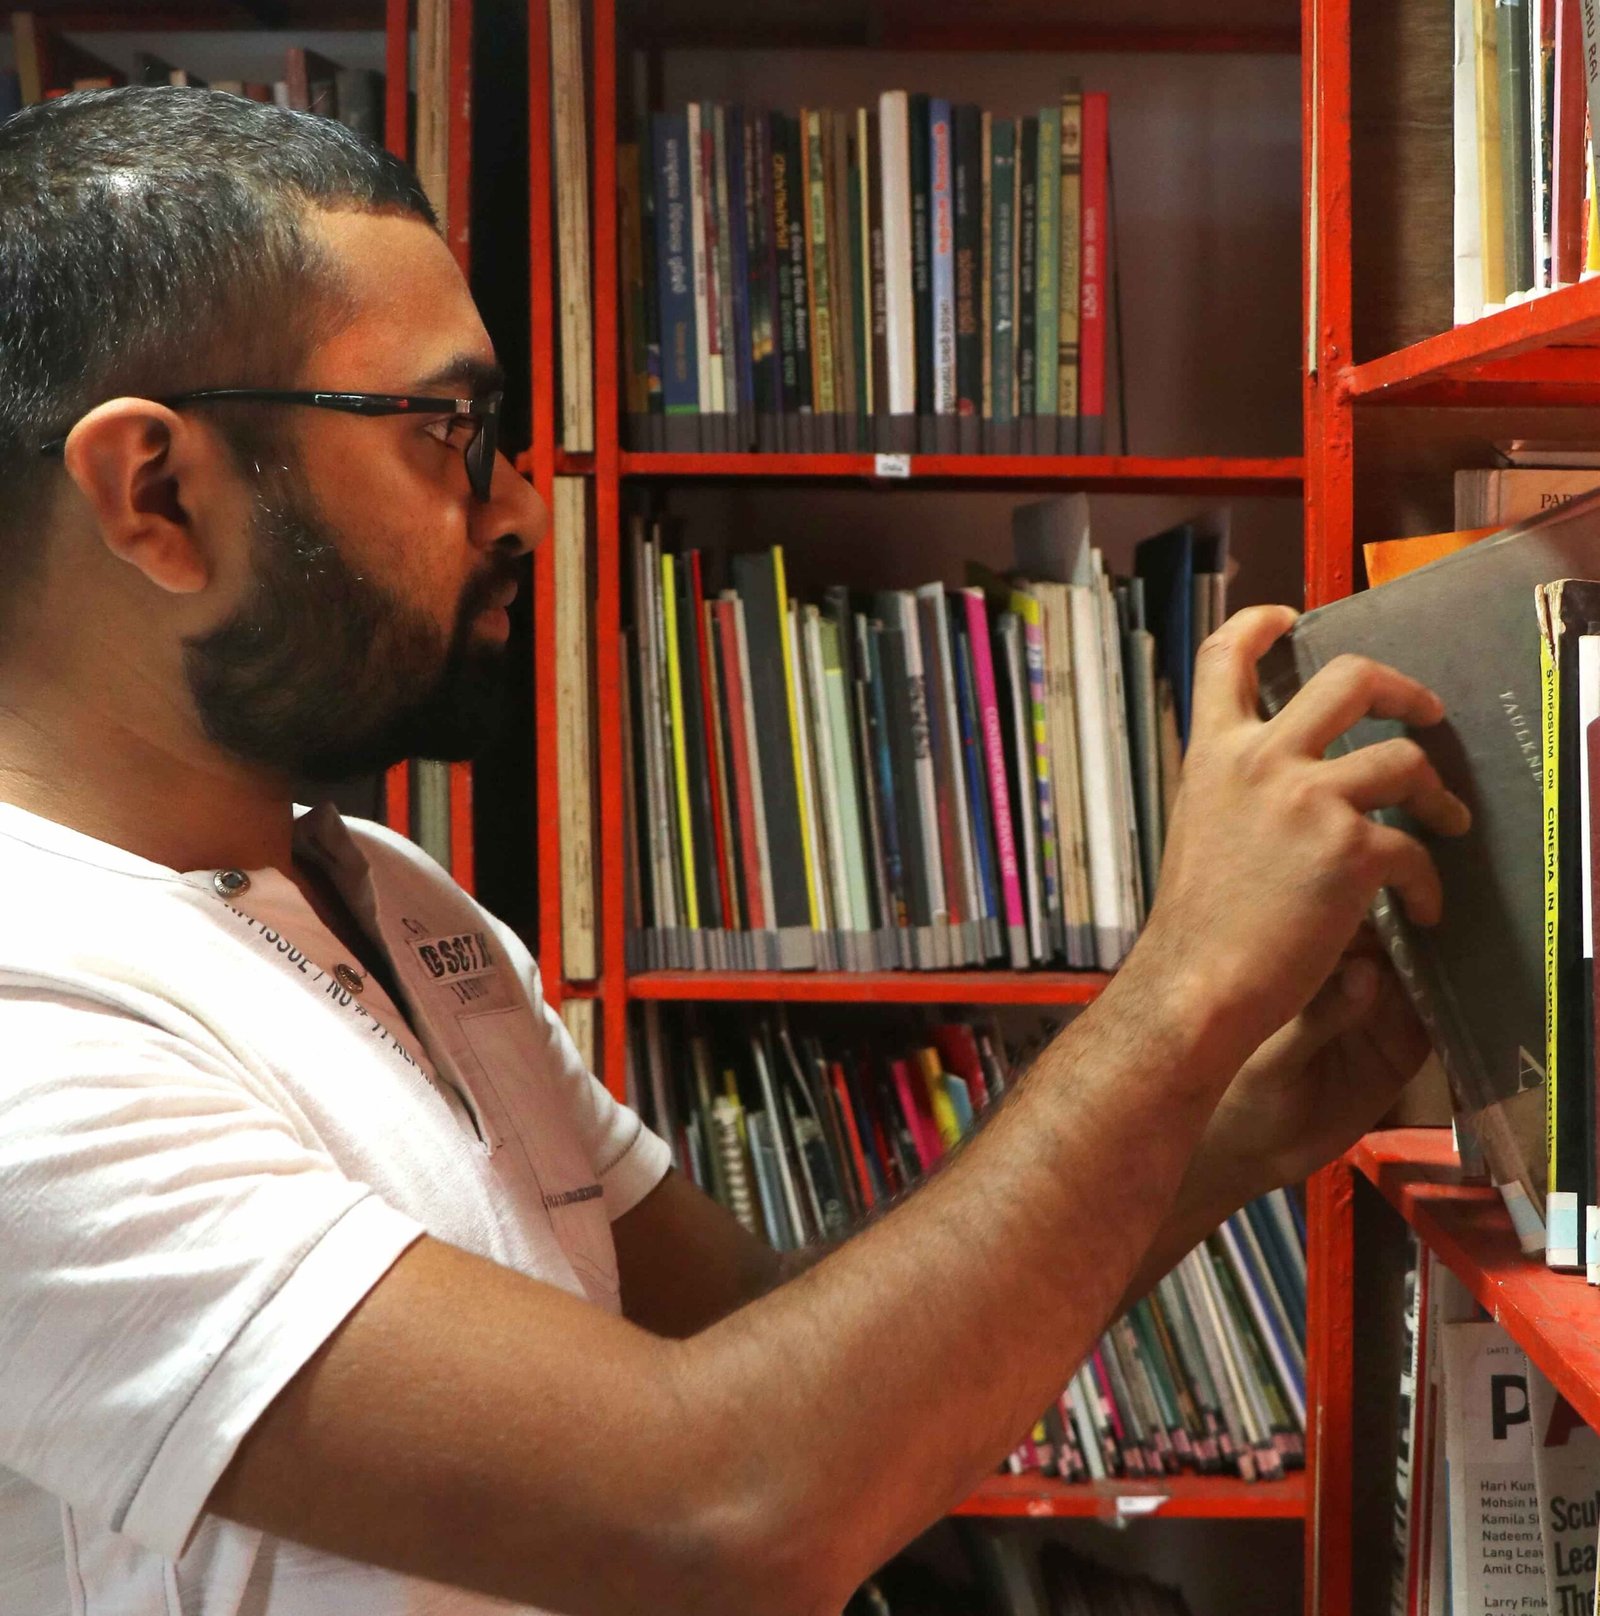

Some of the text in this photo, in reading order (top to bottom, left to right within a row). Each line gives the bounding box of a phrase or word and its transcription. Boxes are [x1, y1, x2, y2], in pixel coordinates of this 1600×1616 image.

[1588, 42, 1598, 83] RAI
[1499, 691, 1543, 796] FAULKNE
[1547, 768, 1554, 789] ON
[1548, 892, 1554, 911] IN
[1491, 1374, 1530, 1440] P
[1480, 1480, 1536, 1492] Hari Kun
[1481, 1497, 1526, 1508] Mohsin
[1482, 1513, 1525, 1525] Kamila
[1482, 1530, 1534, 1541] Nadeem
[1482, 1547, 1513, 1560] Lang
[1483, 1564, 1512, 1575] Amit
[1484, 1596, 1549, 1610] Larry Fink
